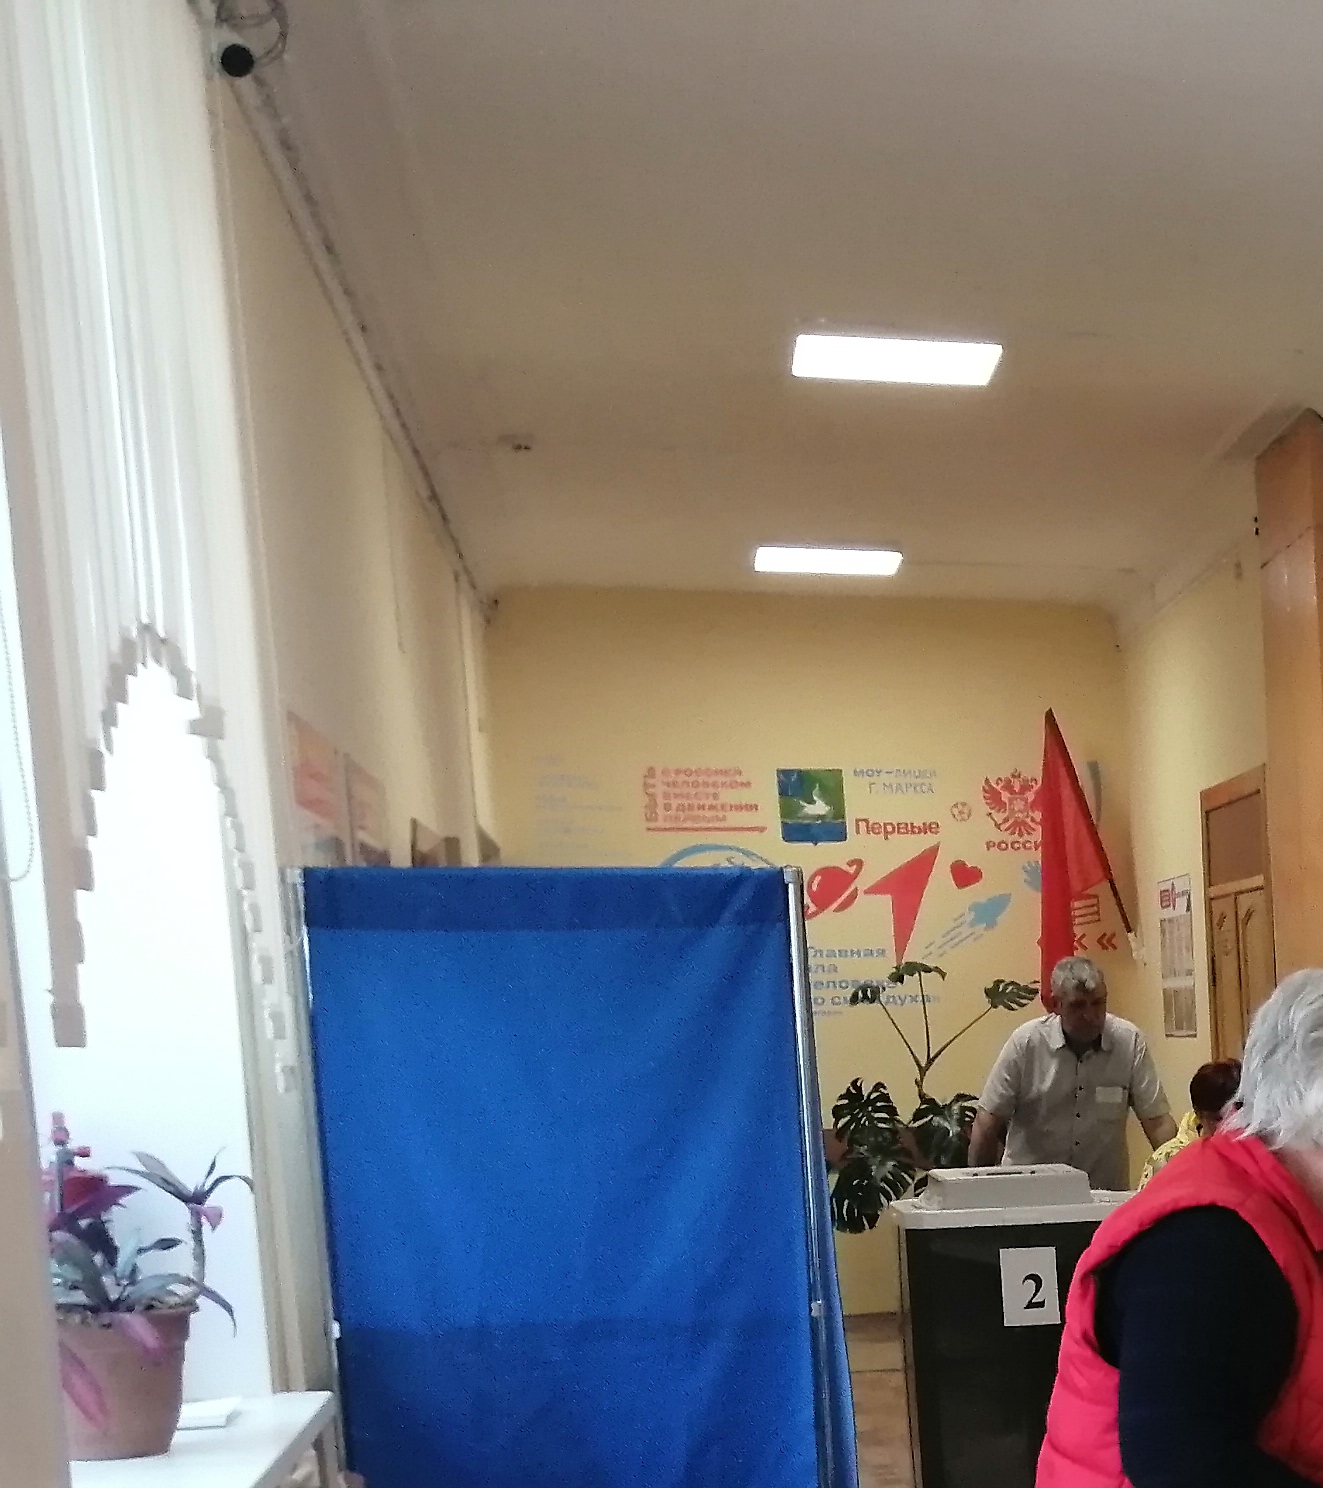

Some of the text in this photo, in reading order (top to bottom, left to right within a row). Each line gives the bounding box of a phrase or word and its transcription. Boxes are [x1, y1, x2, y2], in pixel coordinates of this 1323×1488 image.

[854, 817, 942, 841] Первые
[985, 839, 1041, 852] РОССИ
[1021, 1273, 1046, 1310] 2
